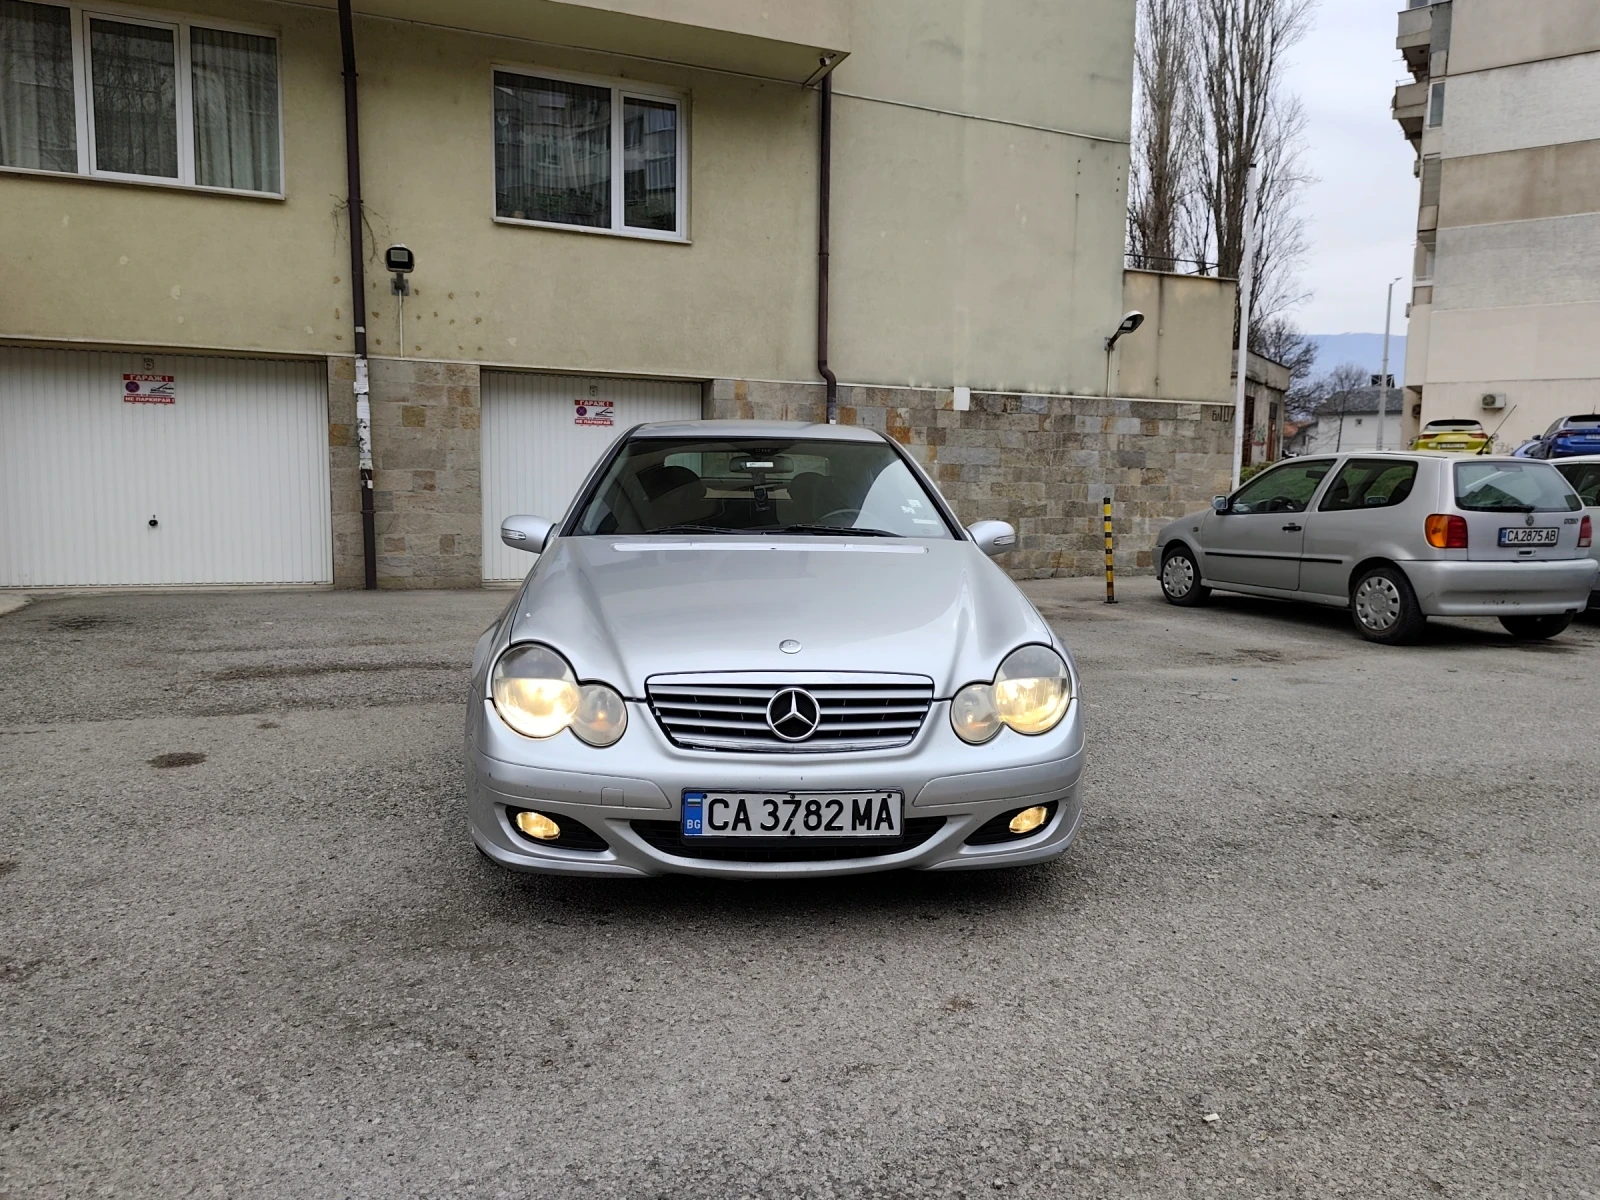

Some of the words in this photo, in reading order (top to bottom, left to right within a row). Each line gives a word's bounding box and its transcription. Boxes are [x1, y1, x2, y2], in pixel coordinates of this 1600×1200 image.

[1520, 530, 1544, 542] 2875
[707, 798, 752, 831] CA
[760, 798, 844, 832] 3782
[851, 798, 895, 831] MA
[686, 819, 701, 830] BG
